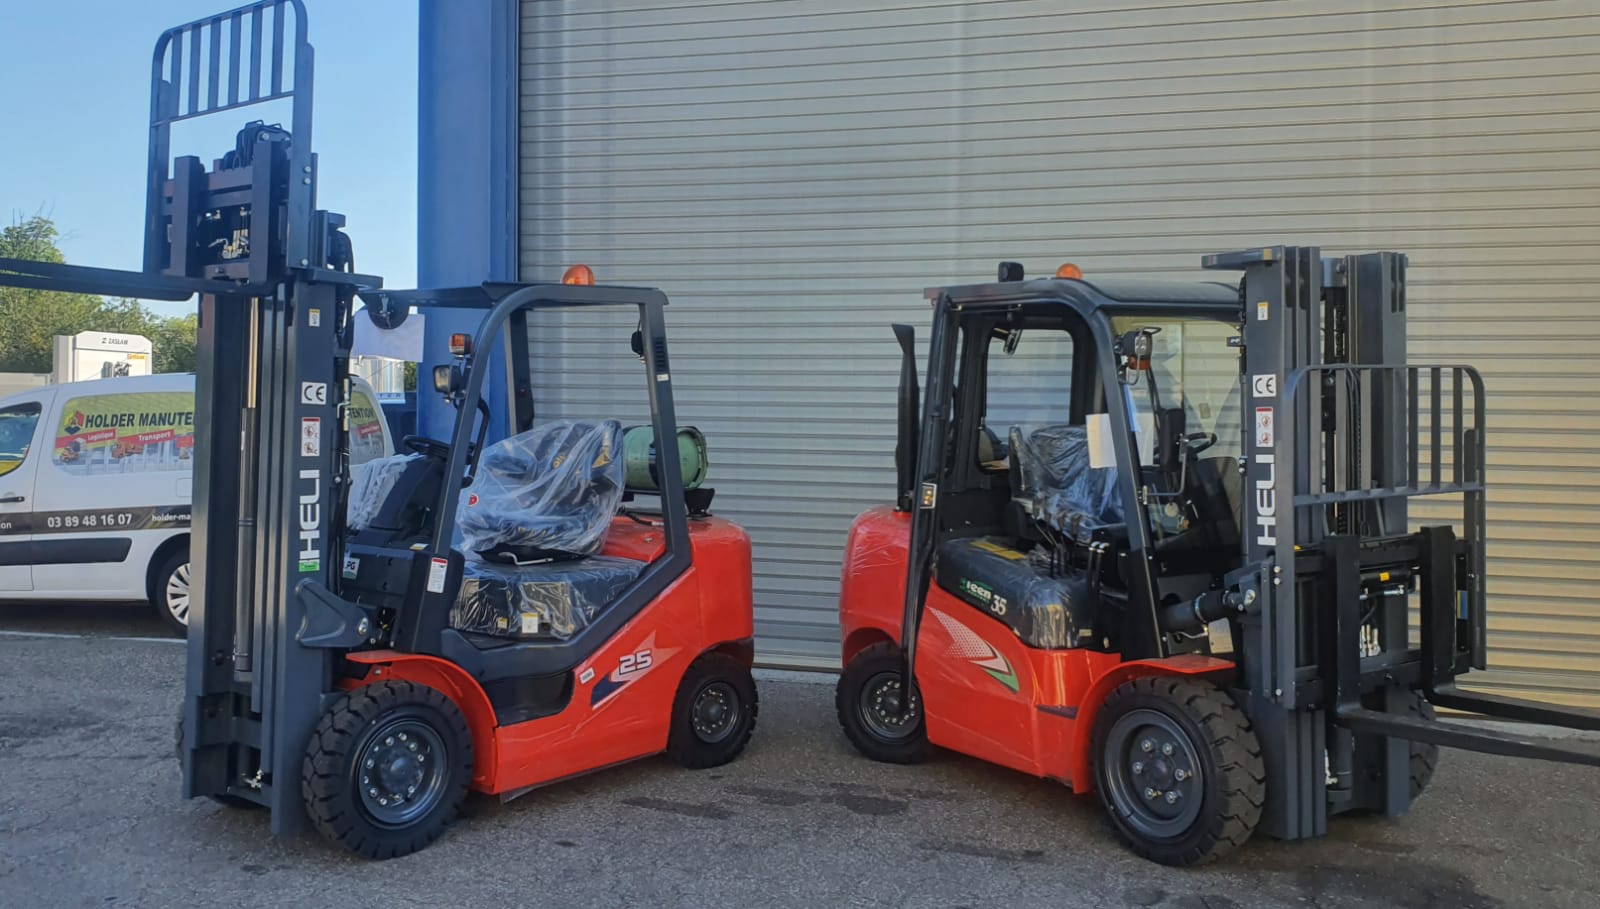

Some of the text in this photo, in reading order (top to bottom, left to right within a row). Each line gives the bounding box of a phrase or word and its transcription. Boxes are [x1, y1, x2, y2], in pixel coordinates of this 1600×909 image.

[304, 385, 325, 402] CE
[1255, 377, 1274, 394] CE
[85, 412, 195, 428] HOLDER MANUTE
[138, 431, 171, 441] Transport
[1255, 454, 1277, 546] HELI
[47, 517, 61, 528] 03
[65, 516, 79, 527] 89
[82, 515, 97, 526] 48
[100, 514, 114, 525] 16
[117, 513, 132, 525] 07
[299, 469, 320, 560] HELI
[991, 594, 1007, 615] 35
[619, 649, 652, 675] 25
